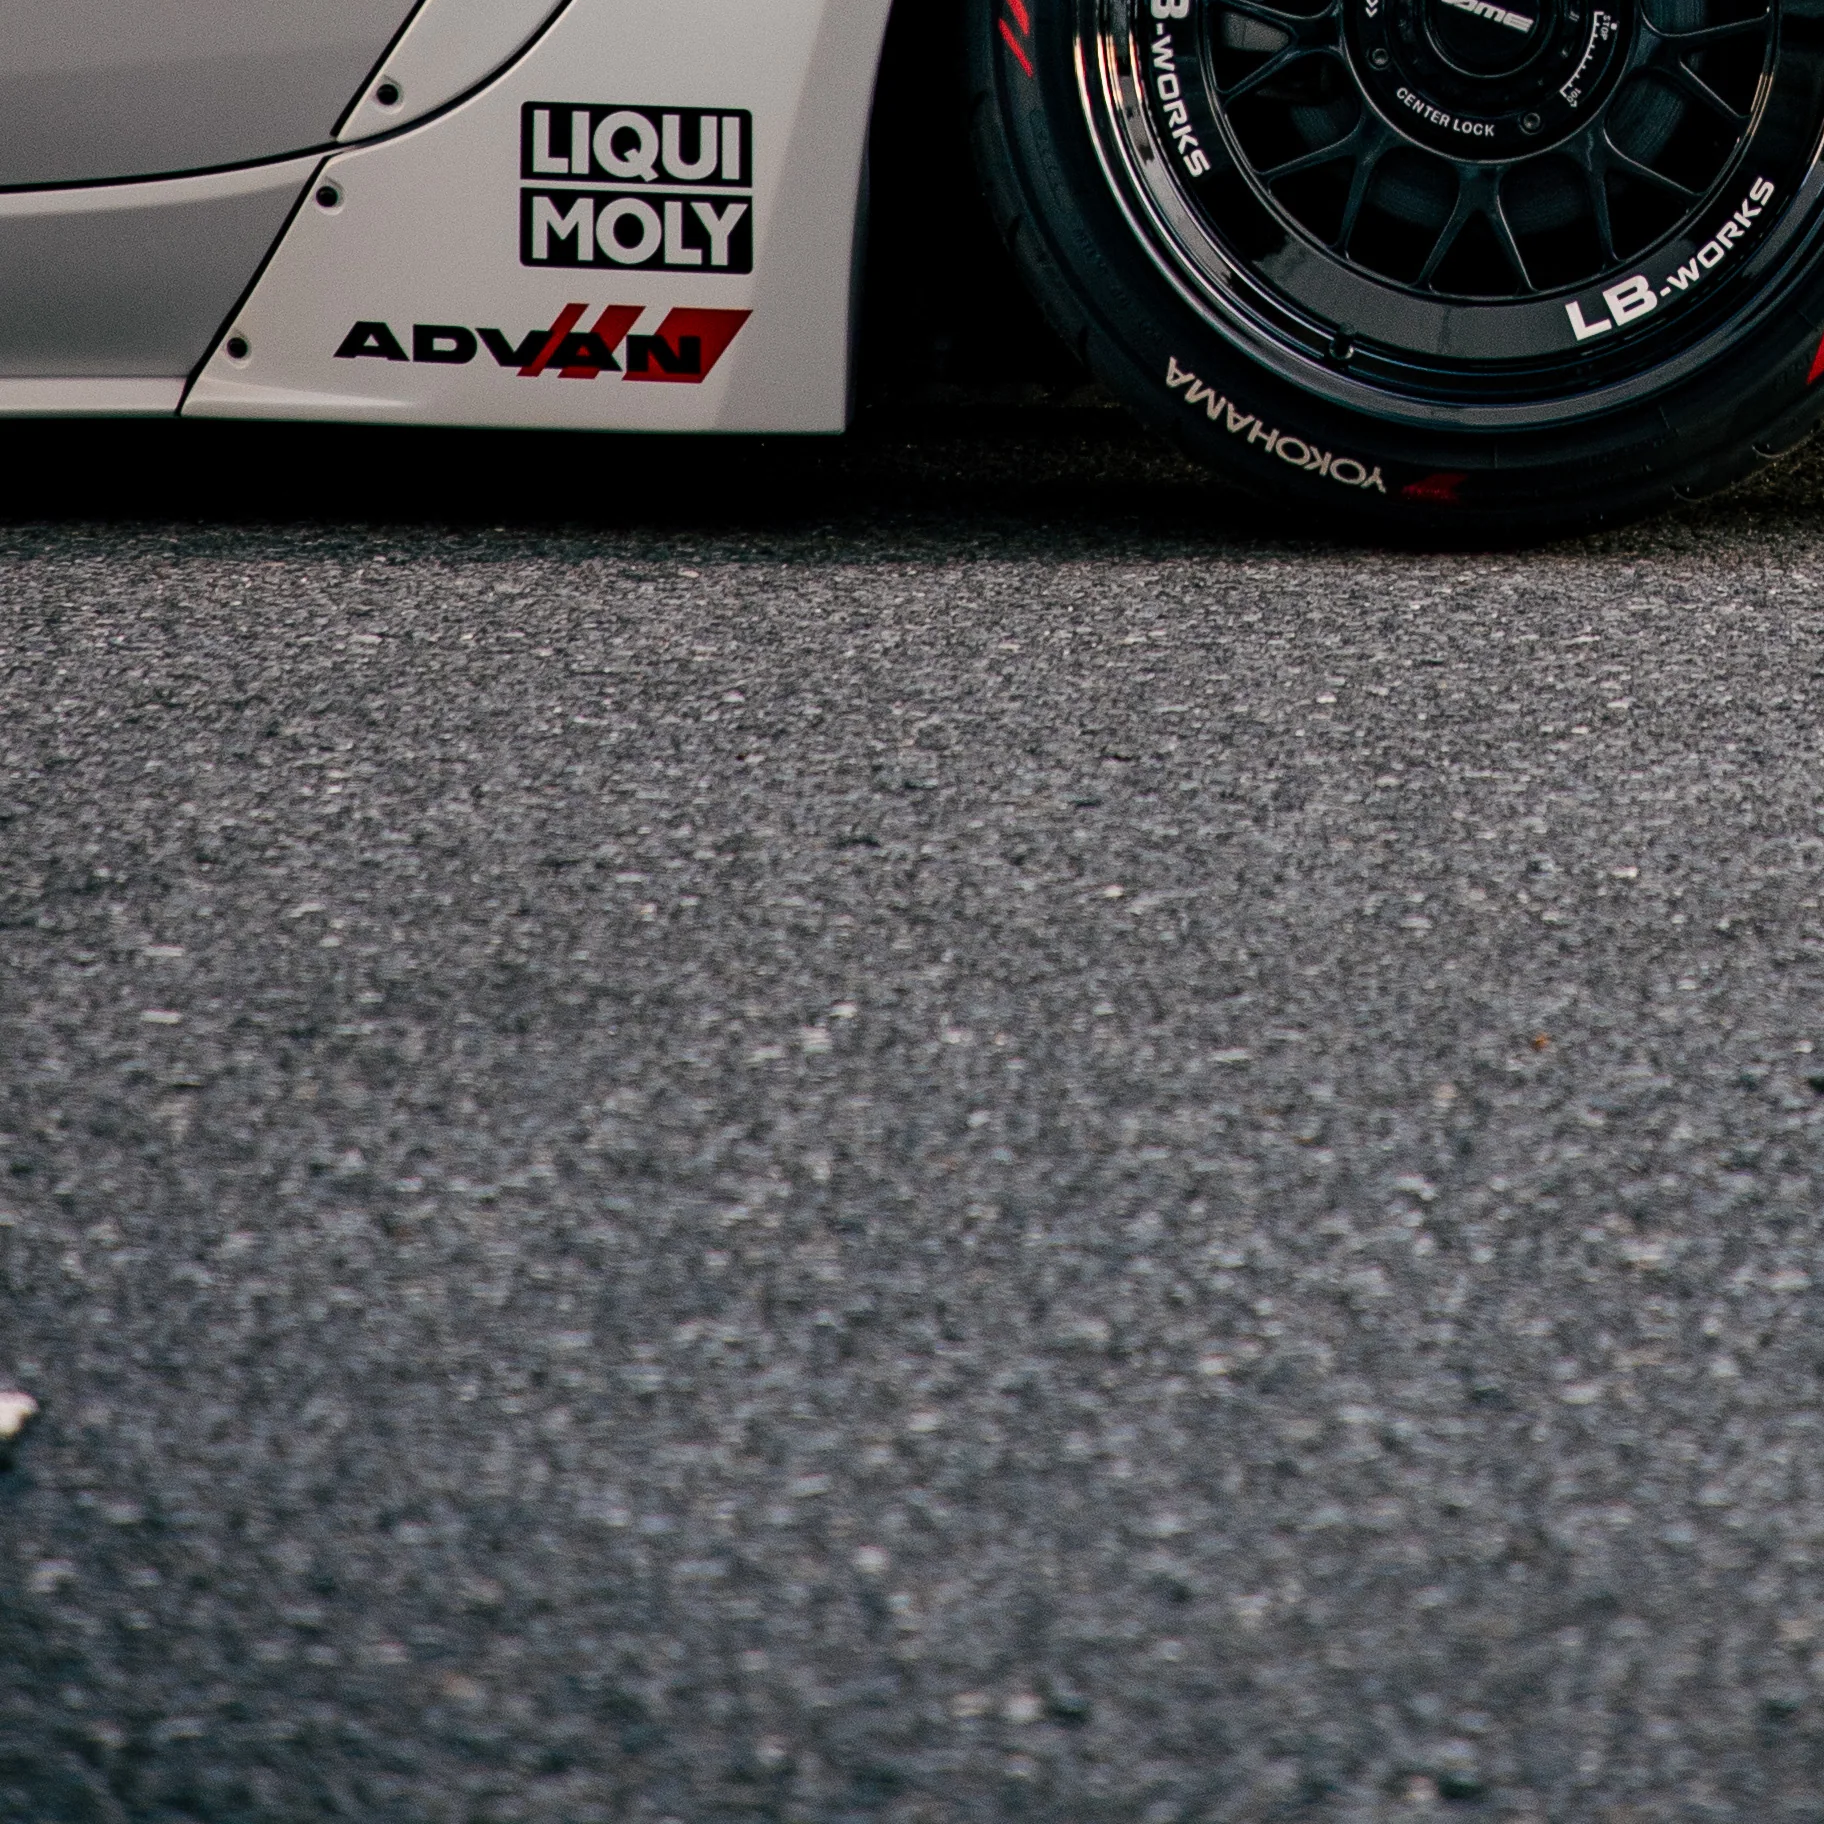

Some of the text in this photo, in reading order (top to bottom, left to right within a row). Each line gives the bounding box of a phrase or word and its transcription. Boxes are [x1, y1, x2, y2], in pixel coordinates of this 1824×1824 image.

[533, 109, 740, 182] LIQUI
[1396, 86, 1496, 137] CENTER LOCK
[532, 196, 749, 266] MOLY
[1564, 176, 1775, 342] LB-WORKS
[333, 321, 703, 375] ADVAN
[1165, 356, 1387, 494] YOKOHAMA
